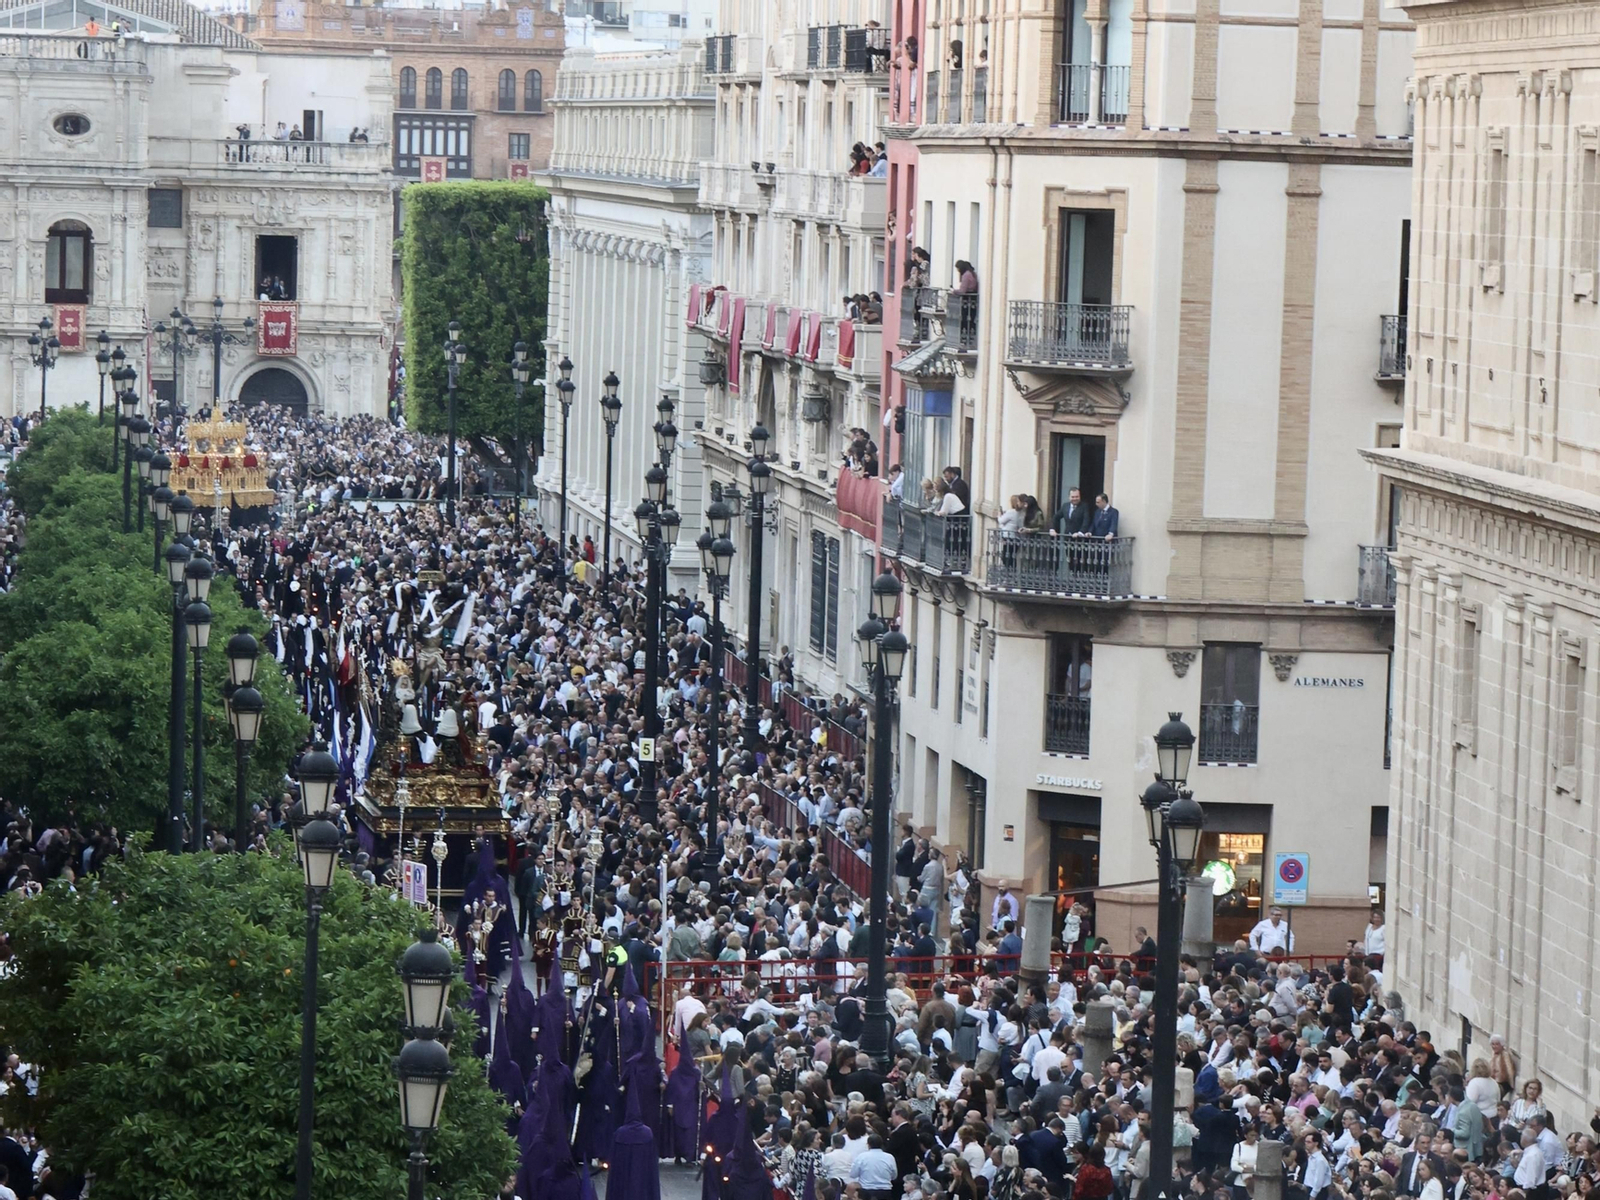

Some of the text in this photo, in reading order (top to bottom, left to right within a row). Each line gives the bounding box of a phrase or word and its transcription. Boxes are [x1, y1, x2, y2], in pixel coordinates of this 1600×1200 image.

[1294, 677, 1364, 687] ALEMANES
[643, 743, 651, 756] 5
[1036, 773, 1102, 790] STARBUCKS
